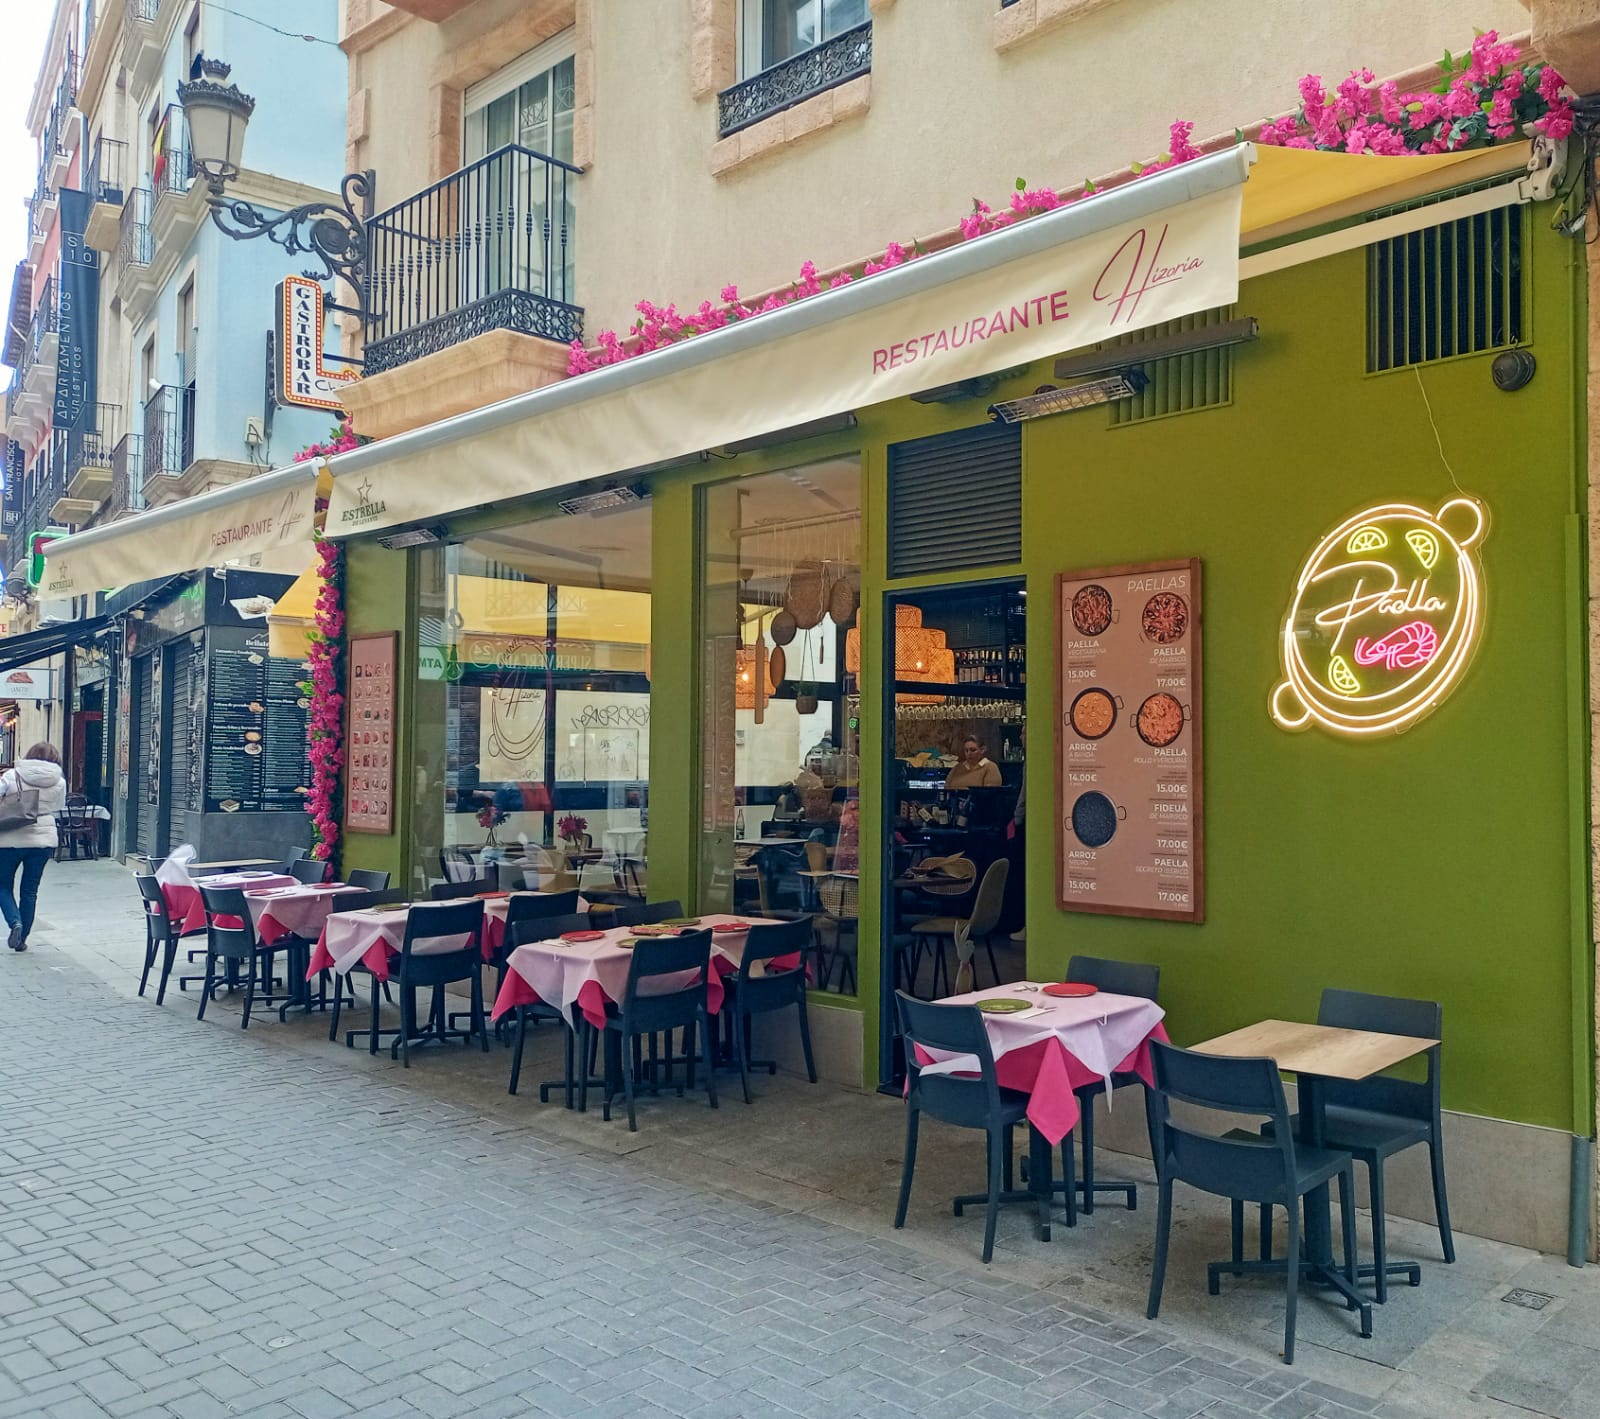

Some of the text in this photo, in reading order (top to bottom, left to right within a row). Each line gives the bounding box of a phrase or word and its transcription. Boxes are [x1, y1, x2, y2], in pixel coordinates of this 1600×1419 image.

[873, 224, 1204, 375] RESTAURANTE Hizoria
[295, 287, 312, 395] GASTROBAR
[57, 291, 72, 420] APARTAMENTOS
[5, 486, 14, 501] SAN
[341, 500, 387, 522] ESTRELLA
[211, 518, 273, 547] RESTAURANTE
[1127, 575, 1187, 593] PAELLAS
[1312, 560, 1447, 656] Paella
[1068, 640, 1099, 649] PAELLA
[1153, 647, 1186, 657] PAELLA
[1068, 669, 1097, 679] 15.00€
[1156, 678, 1187, 688] 17.00€
[1069, 743, 1098, 751] ARROZ
[1154, 748, 1187, 756] PAELLA
[1068, 773, 1097, 782] 14.00€
[1157, 784, 1188, 793] 15.00€
[1157, 839, 1188, 849] 17.00€
[1068, 851, 1097, 860] ARROZ
[1154, 858, 1188, 868] PAELLA
[1069, 880, 1097, 890] 15.00€
[1158, 892, 1189, 903] 17.00€
